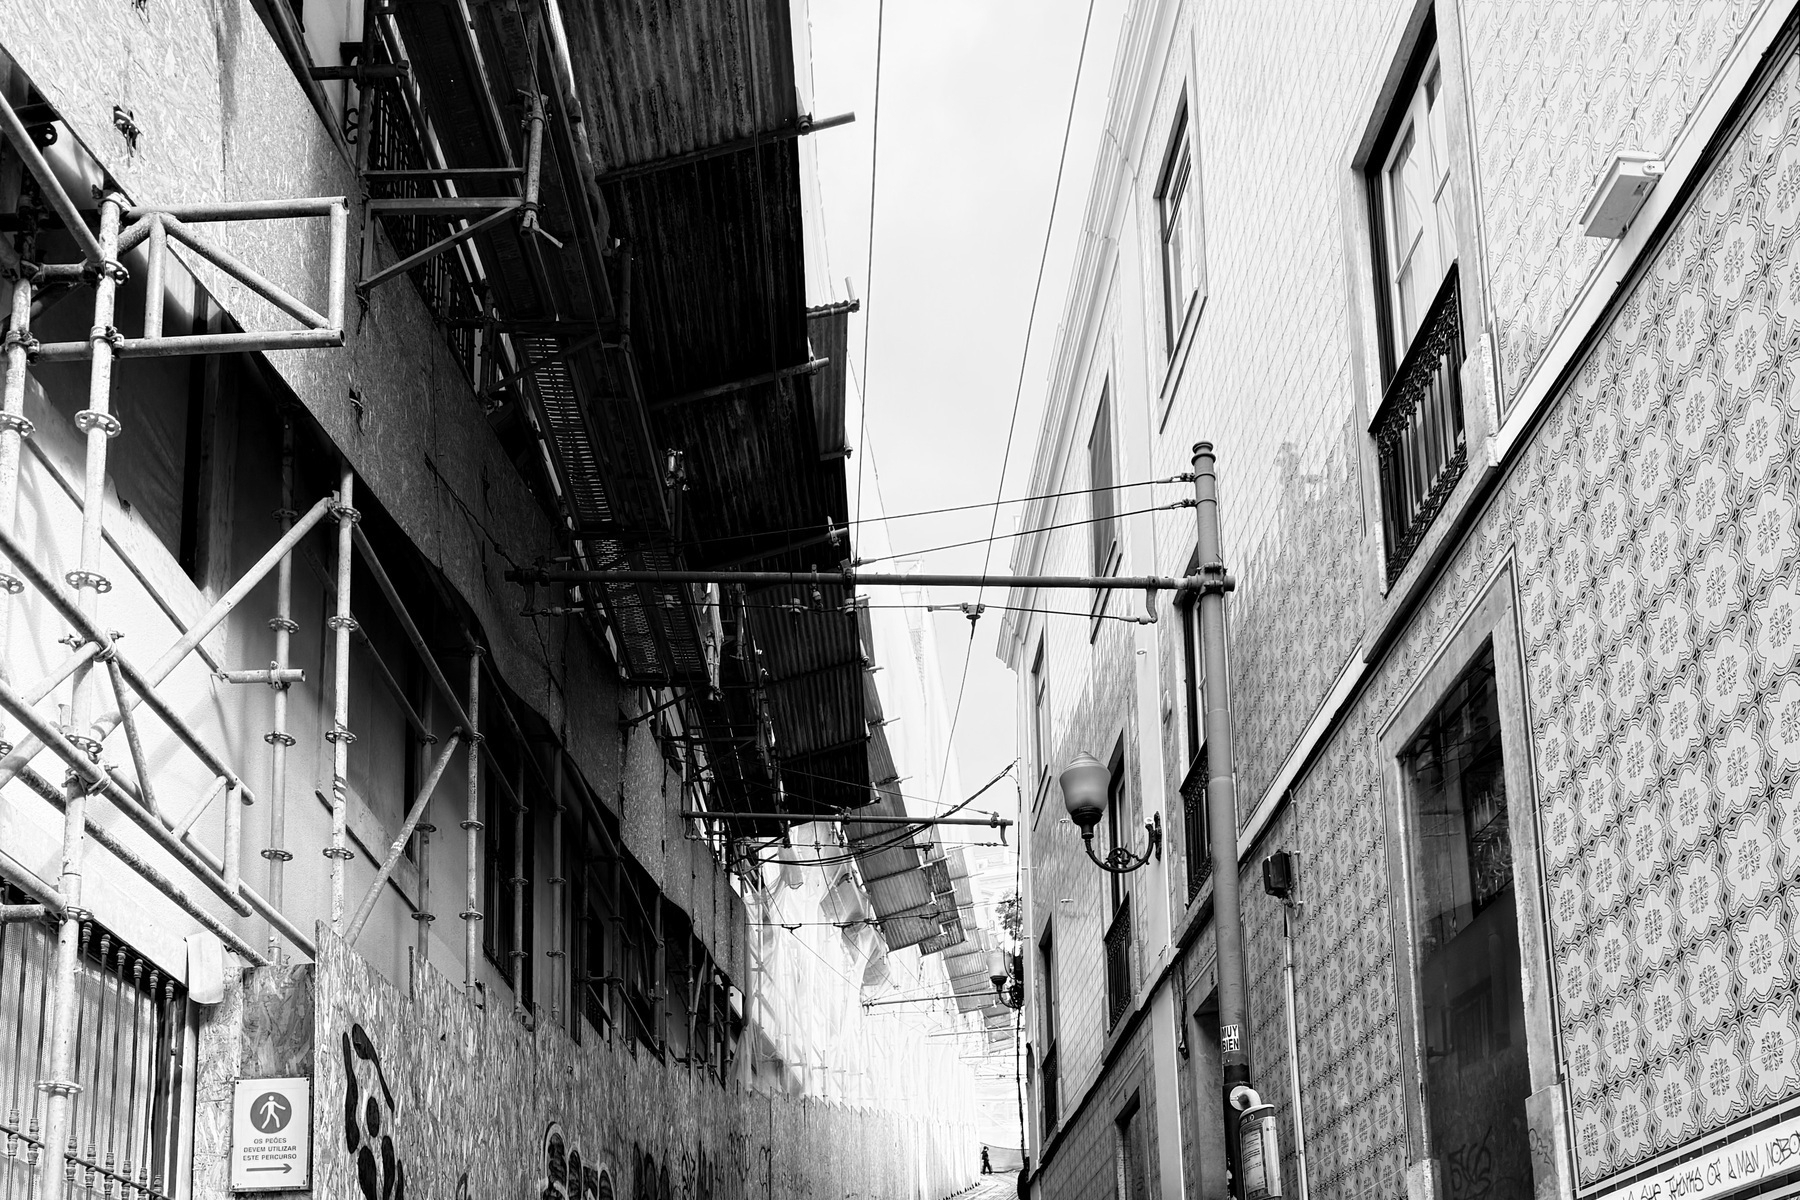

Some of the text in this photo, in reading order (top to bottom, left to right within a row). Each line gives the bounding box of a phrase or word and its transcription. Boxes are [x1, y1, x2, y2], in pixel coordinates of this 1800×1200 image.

[1221, 1025, 1238, 1038] MUY
[1222, 1038, 1239, 1051] BIEN
[1707, 1157, 1722, 1186] OF
[1728, 1156, 1737, 1179] A
